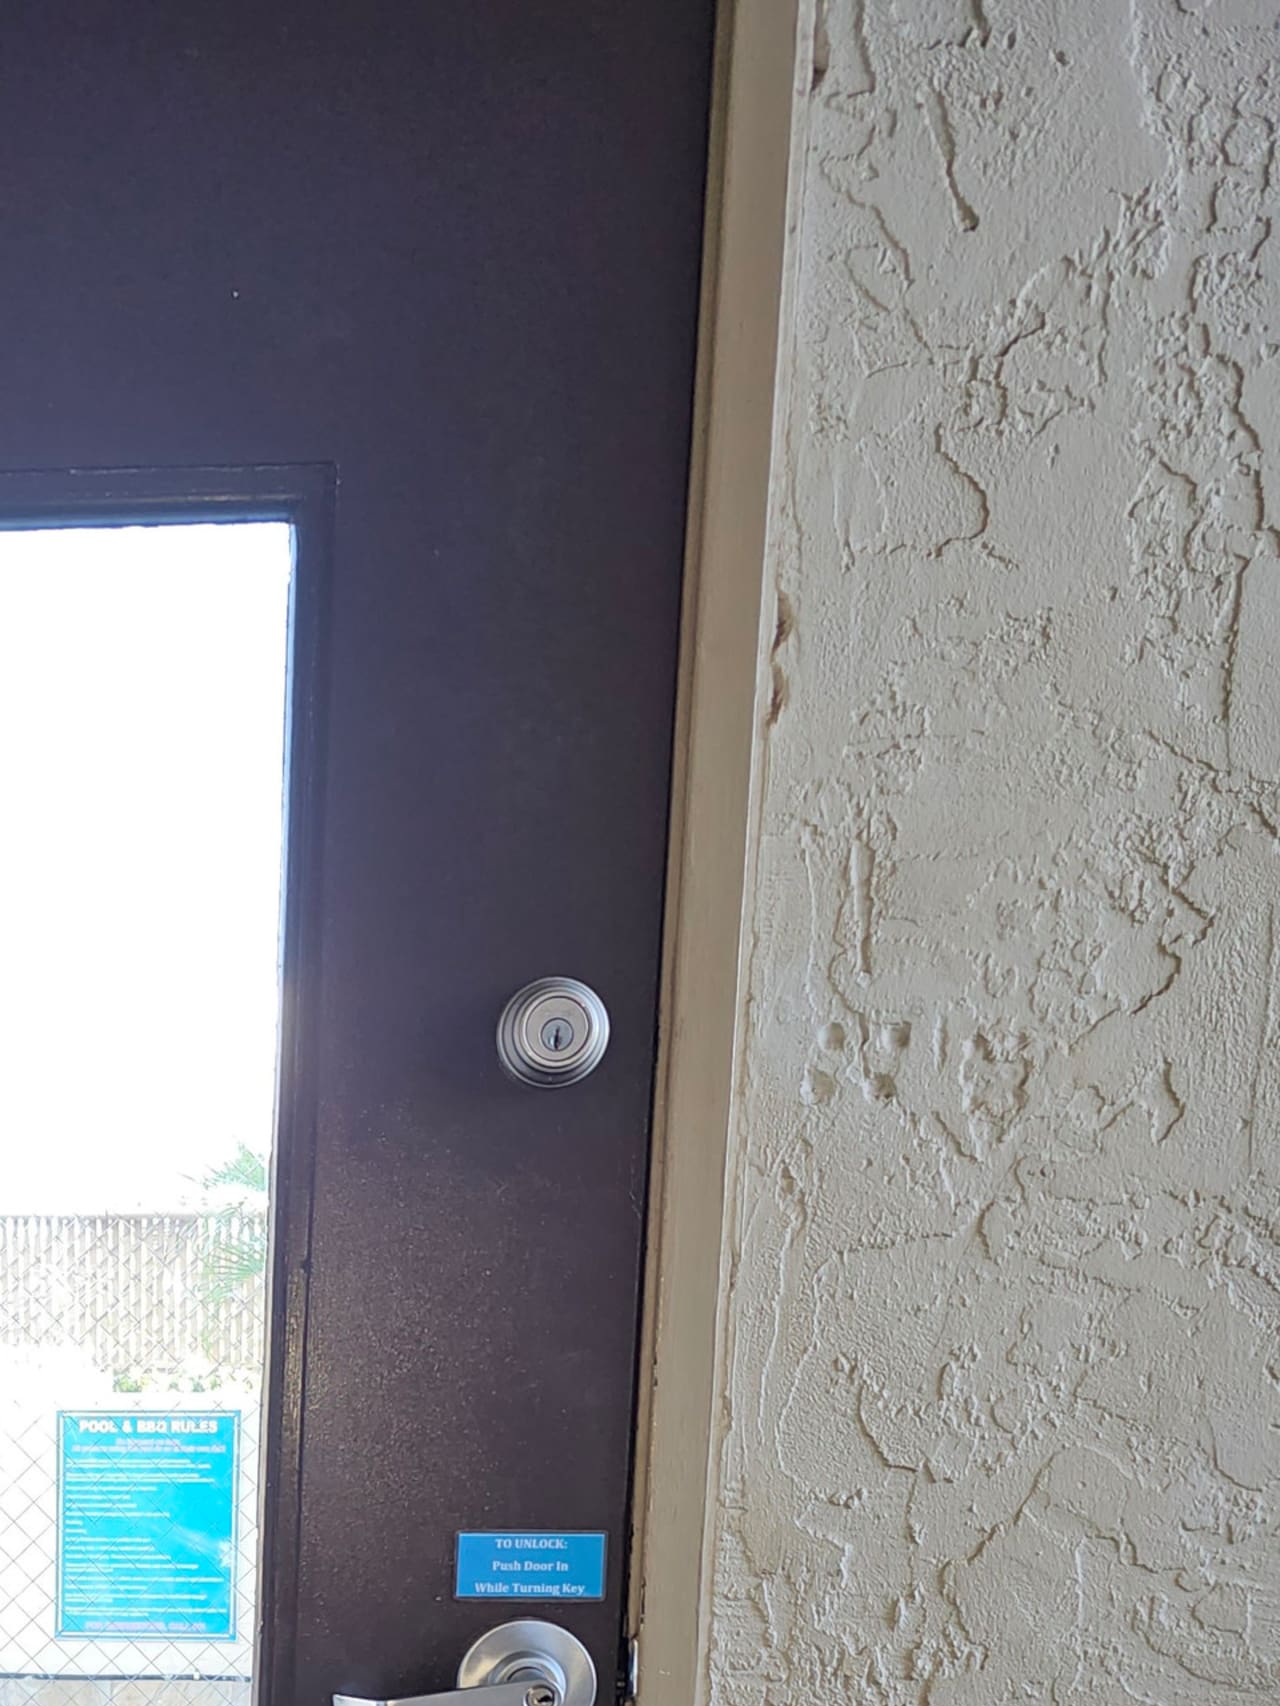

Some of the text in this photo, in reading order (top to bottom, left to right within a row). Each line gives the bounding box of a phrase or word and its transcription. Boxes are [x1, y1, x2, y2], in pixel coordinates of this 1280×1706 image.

[79, 1420, 218, 1433] POOL & BBQ RULES
[495, 1538, 568, 1549] TO UNLOCK:
[492, 1560, 568, 1571] Push Door In
[474, 1582, 585, 1596] While Turning Key
